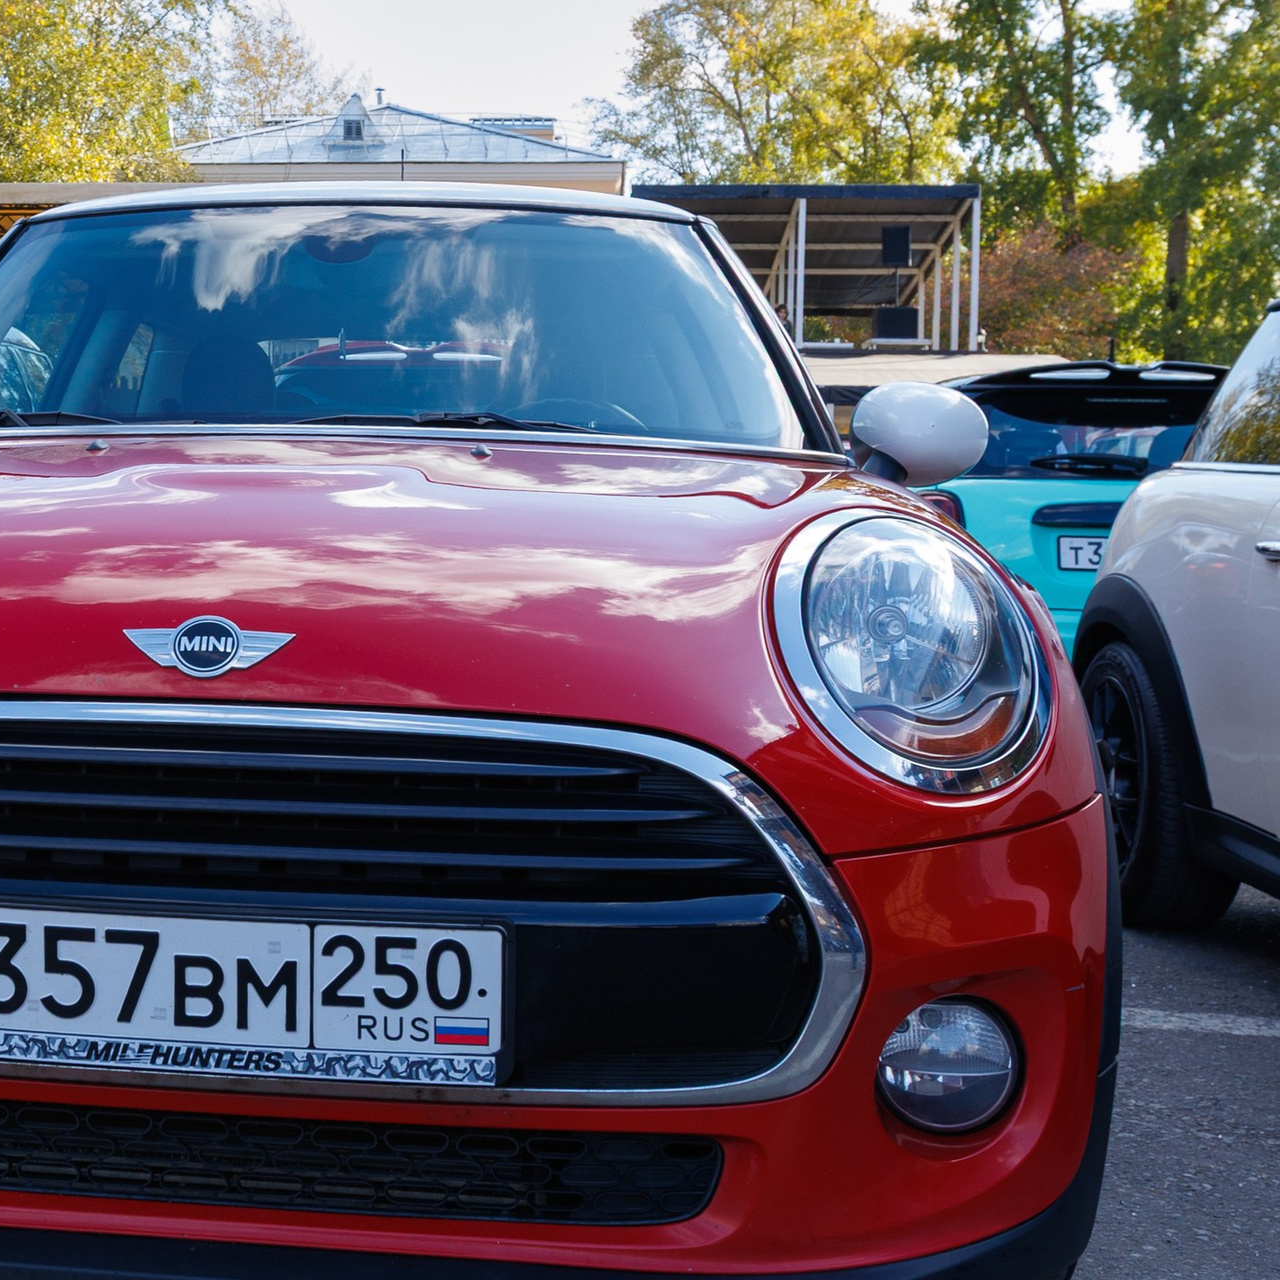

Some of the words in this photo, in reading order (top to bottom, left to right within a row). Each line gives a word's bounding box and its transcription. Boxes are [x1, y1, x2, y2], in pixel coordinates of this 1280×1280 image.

[179, 635, 234, 653] MINI
[321, 934, 472, 1010] 250
[357, 1014, 430, 1042] RUS
